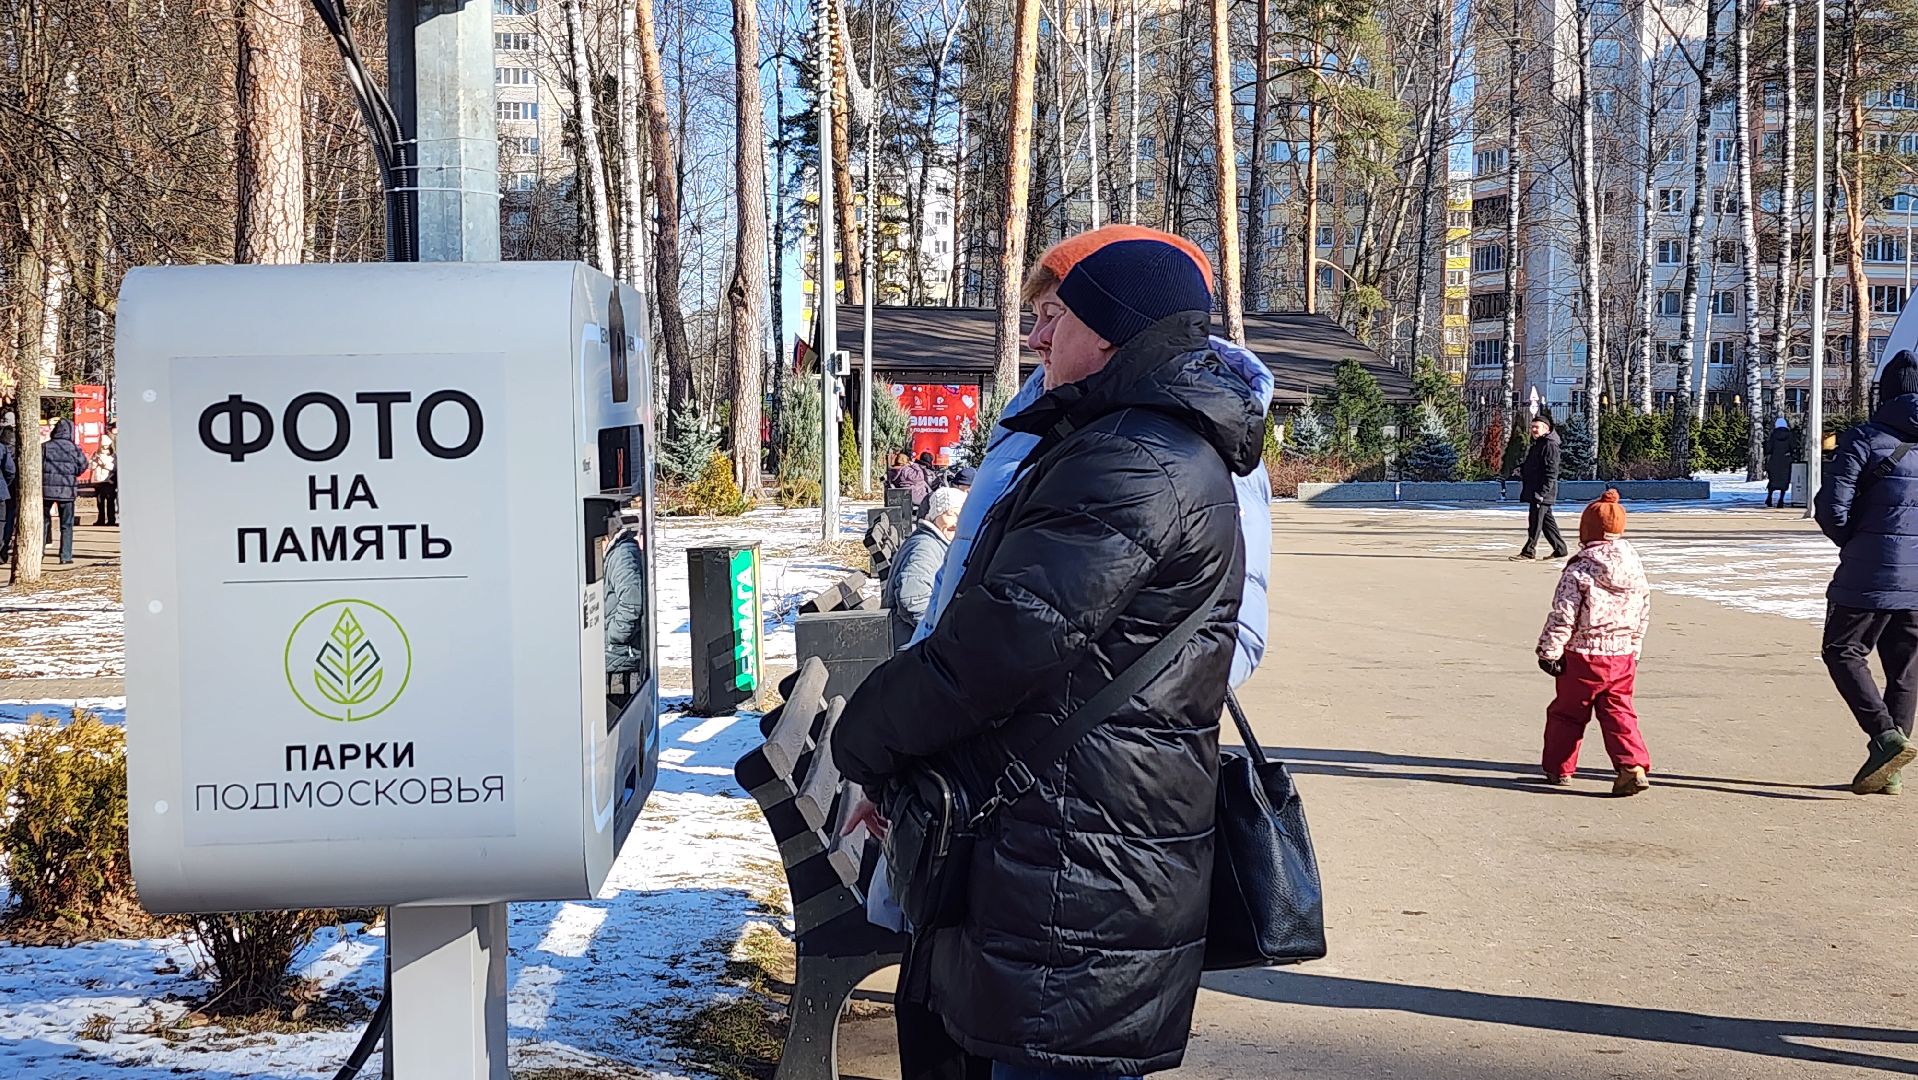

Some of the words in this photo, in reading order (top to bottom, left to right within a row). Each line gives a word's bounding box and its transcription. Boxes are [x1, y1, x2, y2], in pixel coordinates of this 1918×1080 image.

[198, 389, 484, 462] ФОТО
[910, 415, 948, 427] ЗИМА
[308, 473, 379, 510] НА
[237, 524, 453, 563] ПАМЯТЬ
[286, 741, 415, 771] ПАРКИ
[196, 775, 504, 811] ПОДМОСКОВЬЯ
